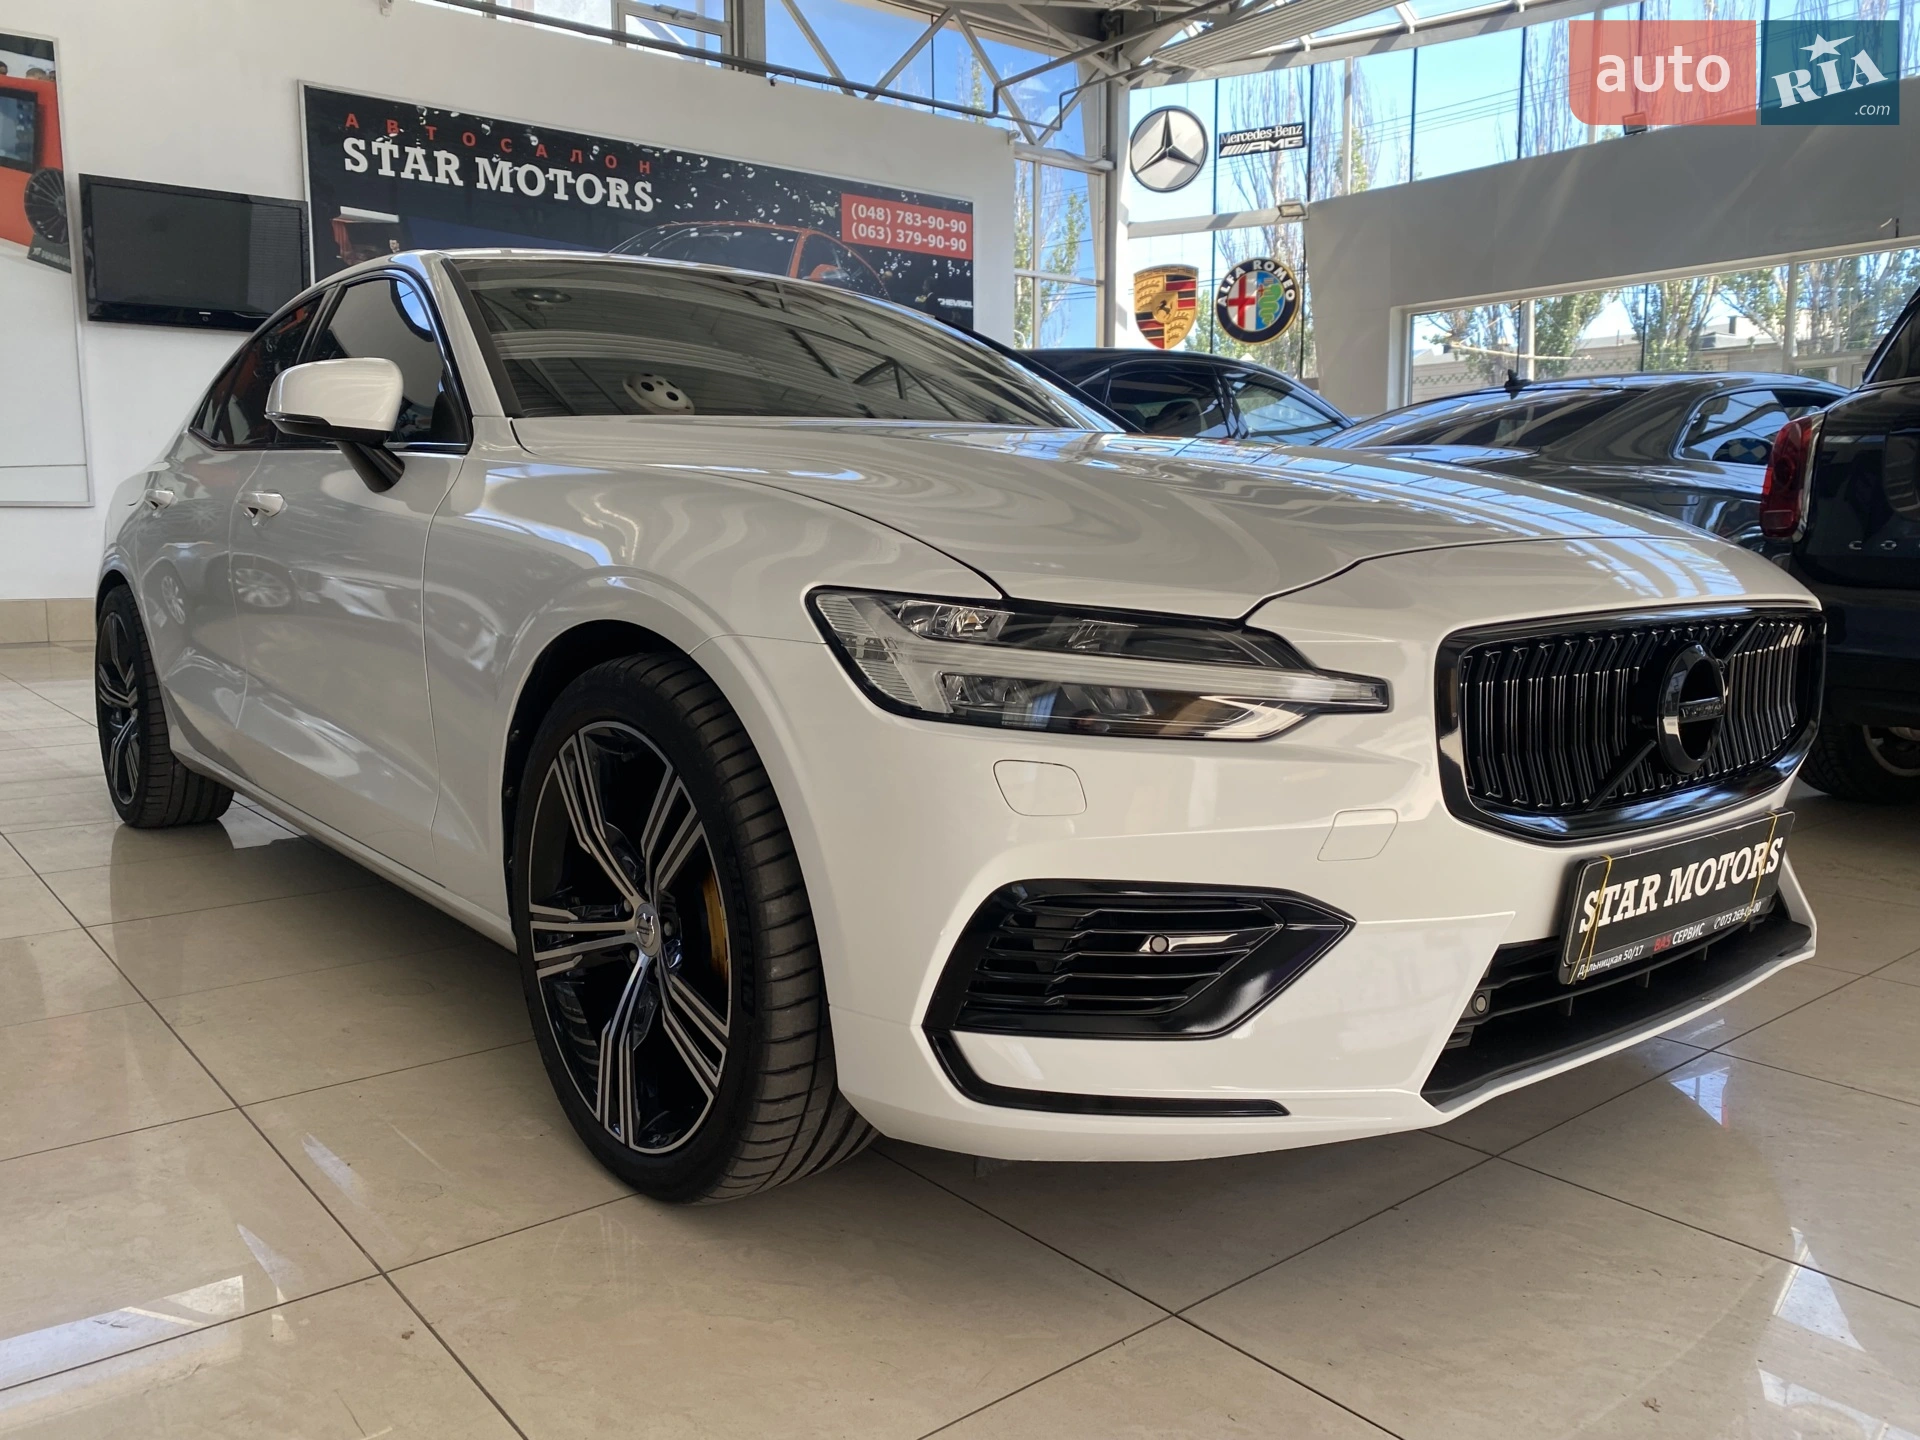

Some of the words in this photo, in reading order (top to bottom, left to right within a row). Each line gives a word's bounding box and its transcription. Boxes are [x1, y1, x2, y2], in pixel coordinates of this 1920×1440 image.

[345, 113, 650, 174] АВТОСАЛОН
[1220, 125, 1302, 144] Mercedes-Benz
[1246, 137, 1303, 153] AMG
[343, 136, 463, 186] STAR
[475, 156, 654, 212] MOTORS
[851, 202, 891, 225] (048)
[896, 210, 967, 234] 783-90-90
[851, 222, 892, 244] (063)
[896, 229, 967, 252] 379-90-90
[1217, 266, 1246, 307] ALFA
[1253, 260, 1295, 301] ROMEO
[1848, 540, 1920, 551] CO
[1578, 873, 1661, 933] STAR
[1663, 837, 1783, 908] MOTORS
[1672, 922, 1705, 945] СЕРВИС
[1623, 945, 1644, 960] 50/17
